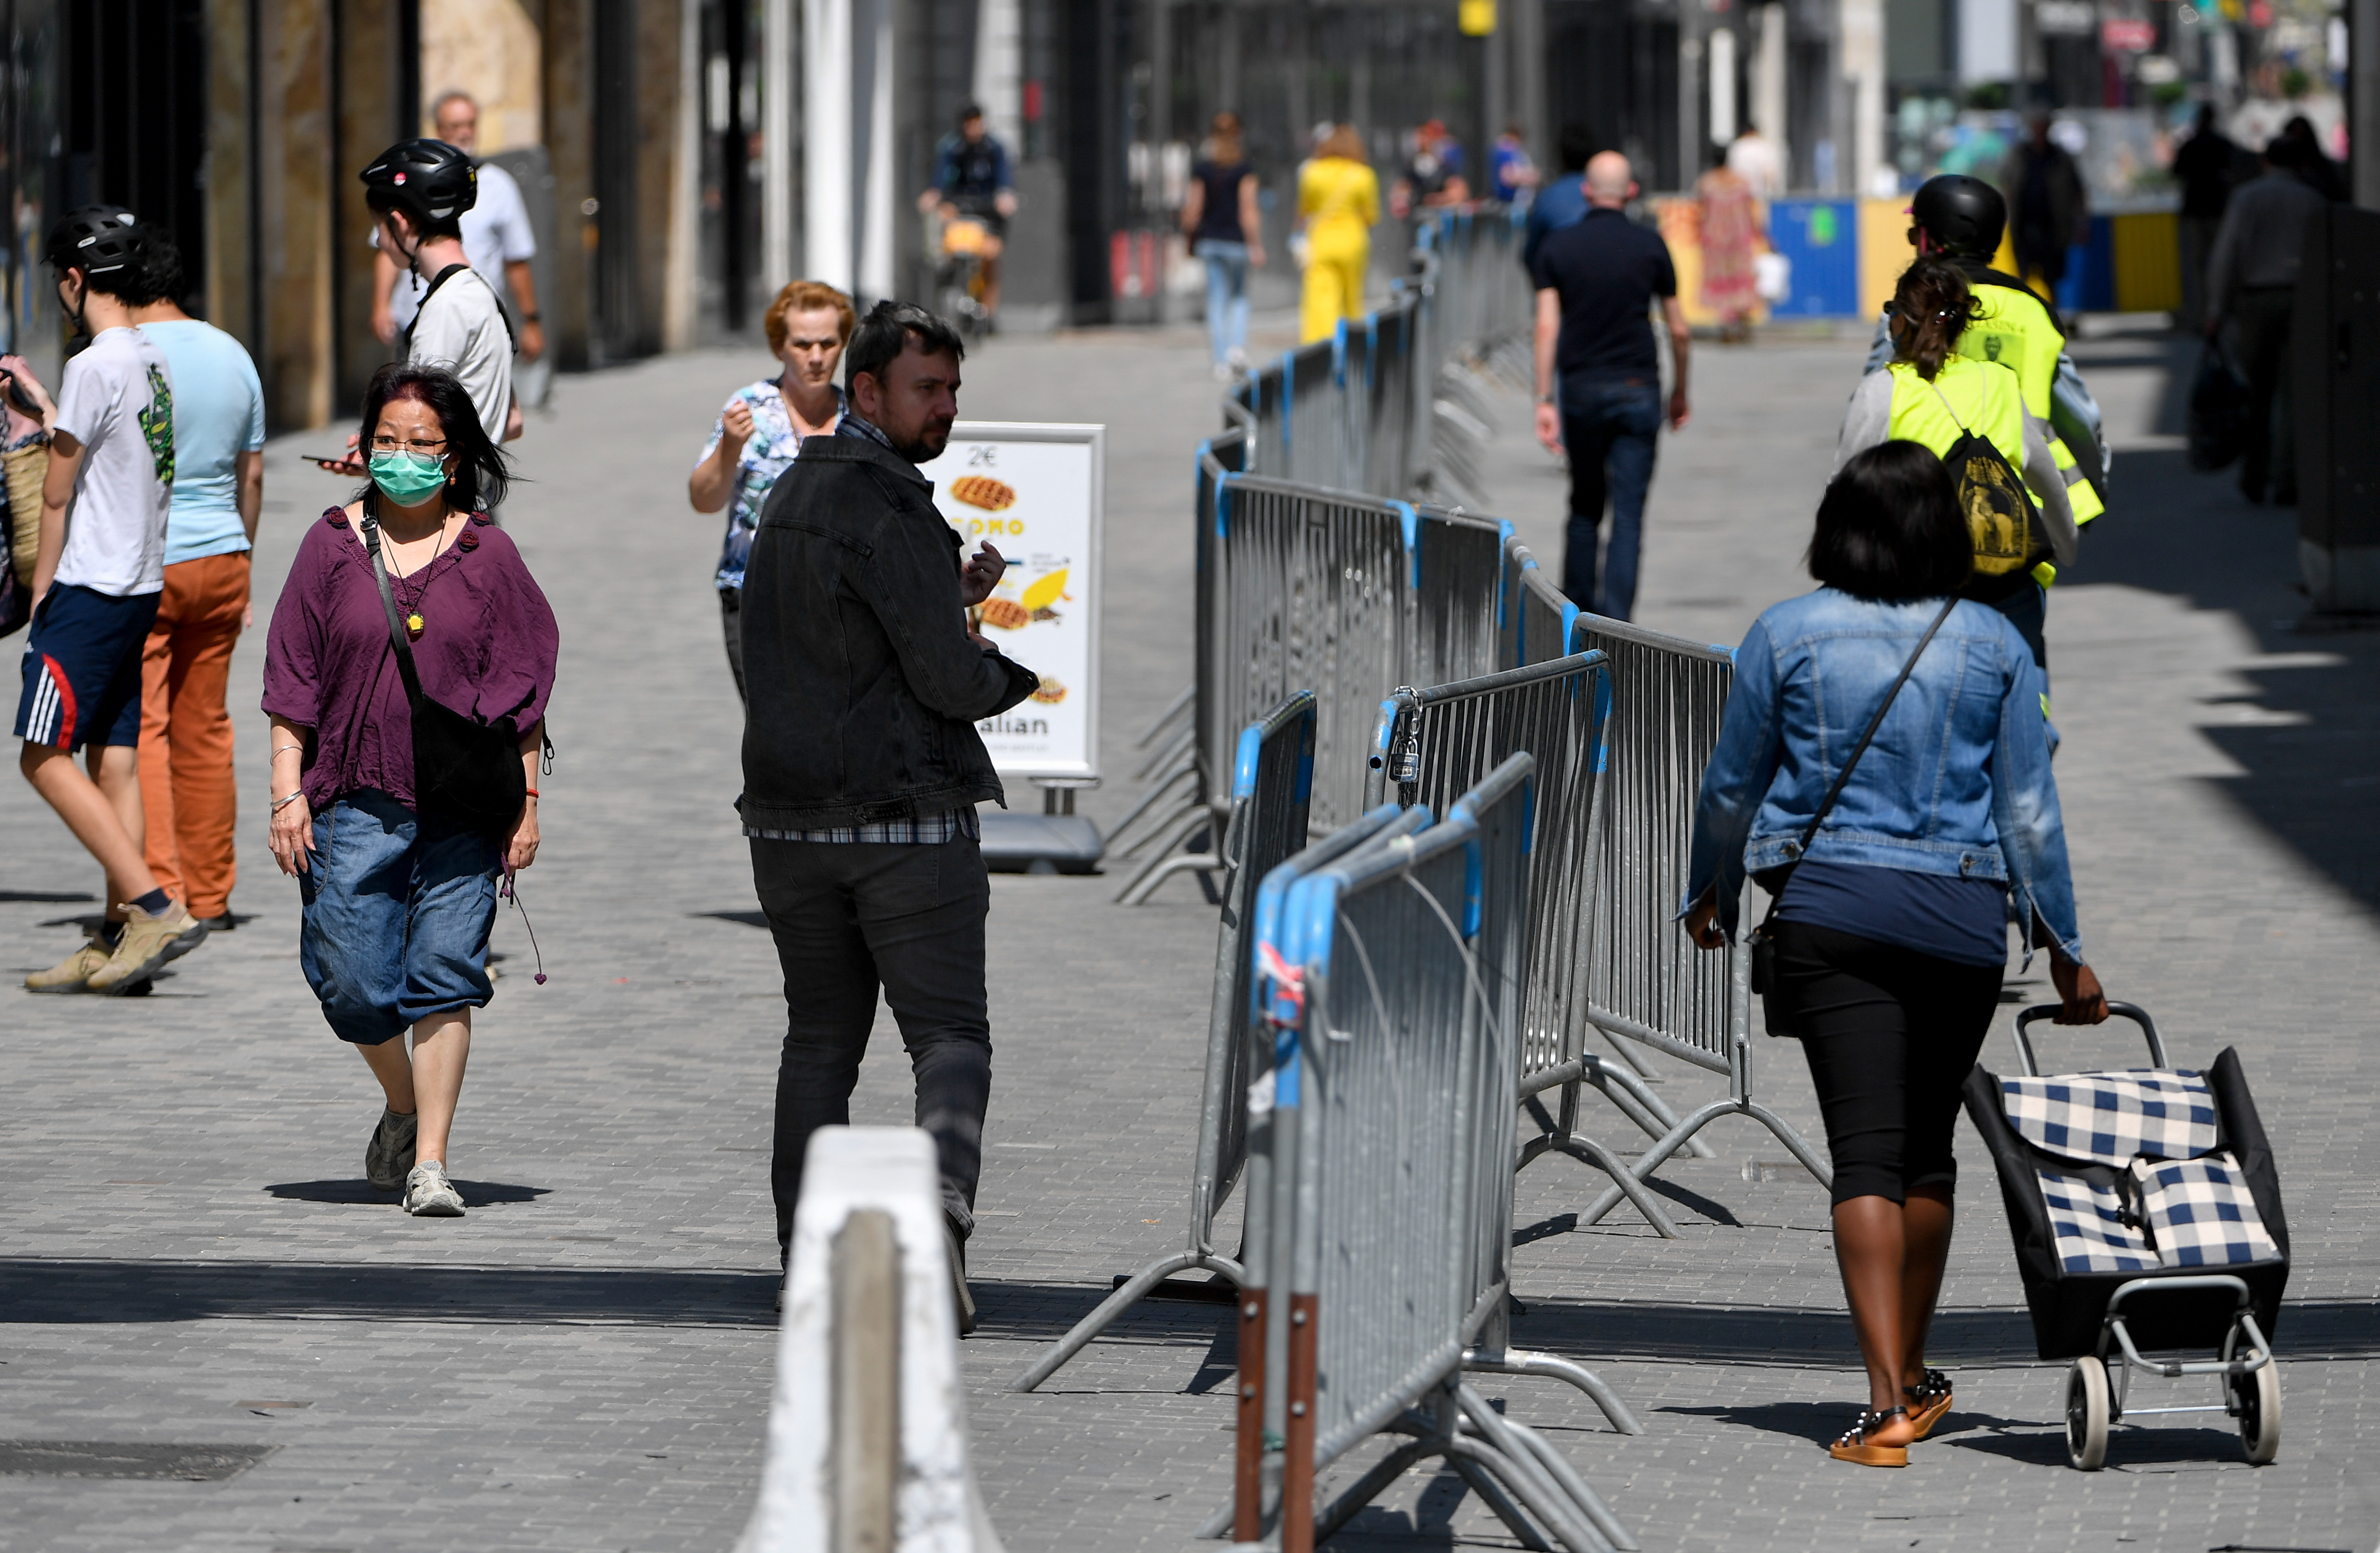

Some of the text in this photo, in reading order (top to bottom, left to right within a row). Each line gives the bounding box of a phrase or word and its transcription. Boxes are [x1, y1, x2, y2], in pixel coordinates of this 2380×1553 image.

[968, 445, 998, 467] 2€
[951, 517, 1024, 536] OMO
[981, 711, 1048, 734] alian
